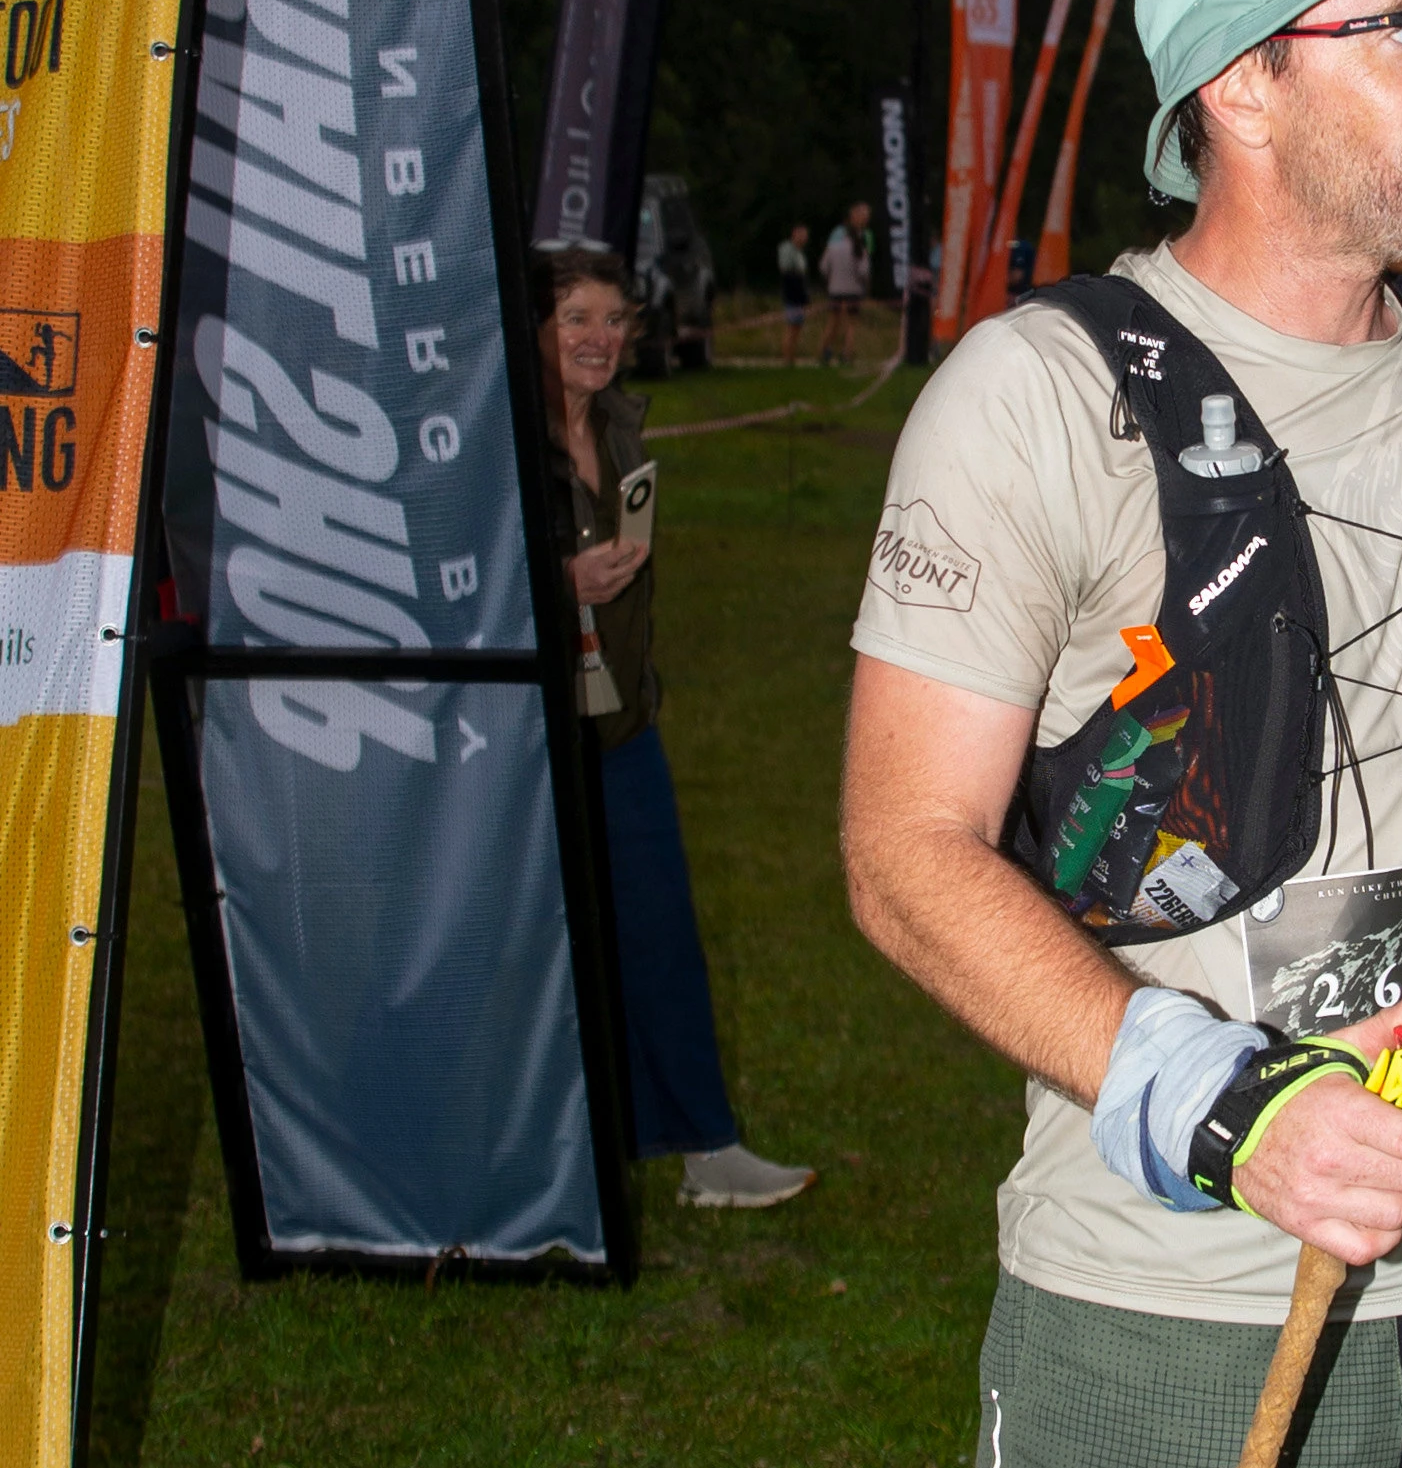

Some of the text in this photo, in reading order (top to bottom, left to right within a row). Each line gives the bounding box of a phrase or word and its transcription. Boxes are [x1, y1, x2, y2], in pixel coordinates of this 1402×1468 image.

[1120, 331, 1166, 351] I'M DAVE
[872, 530, 968, 593] MOUNT
[941, 554, 972, 572] ROUTE
[1188, 534, 1269, 616] SALOMON
[1317, 887, 1346, 899] RUN
[1352, 882, 1384, 895] LIKE
[1259, 1049, 1331, 1080] LEKI
